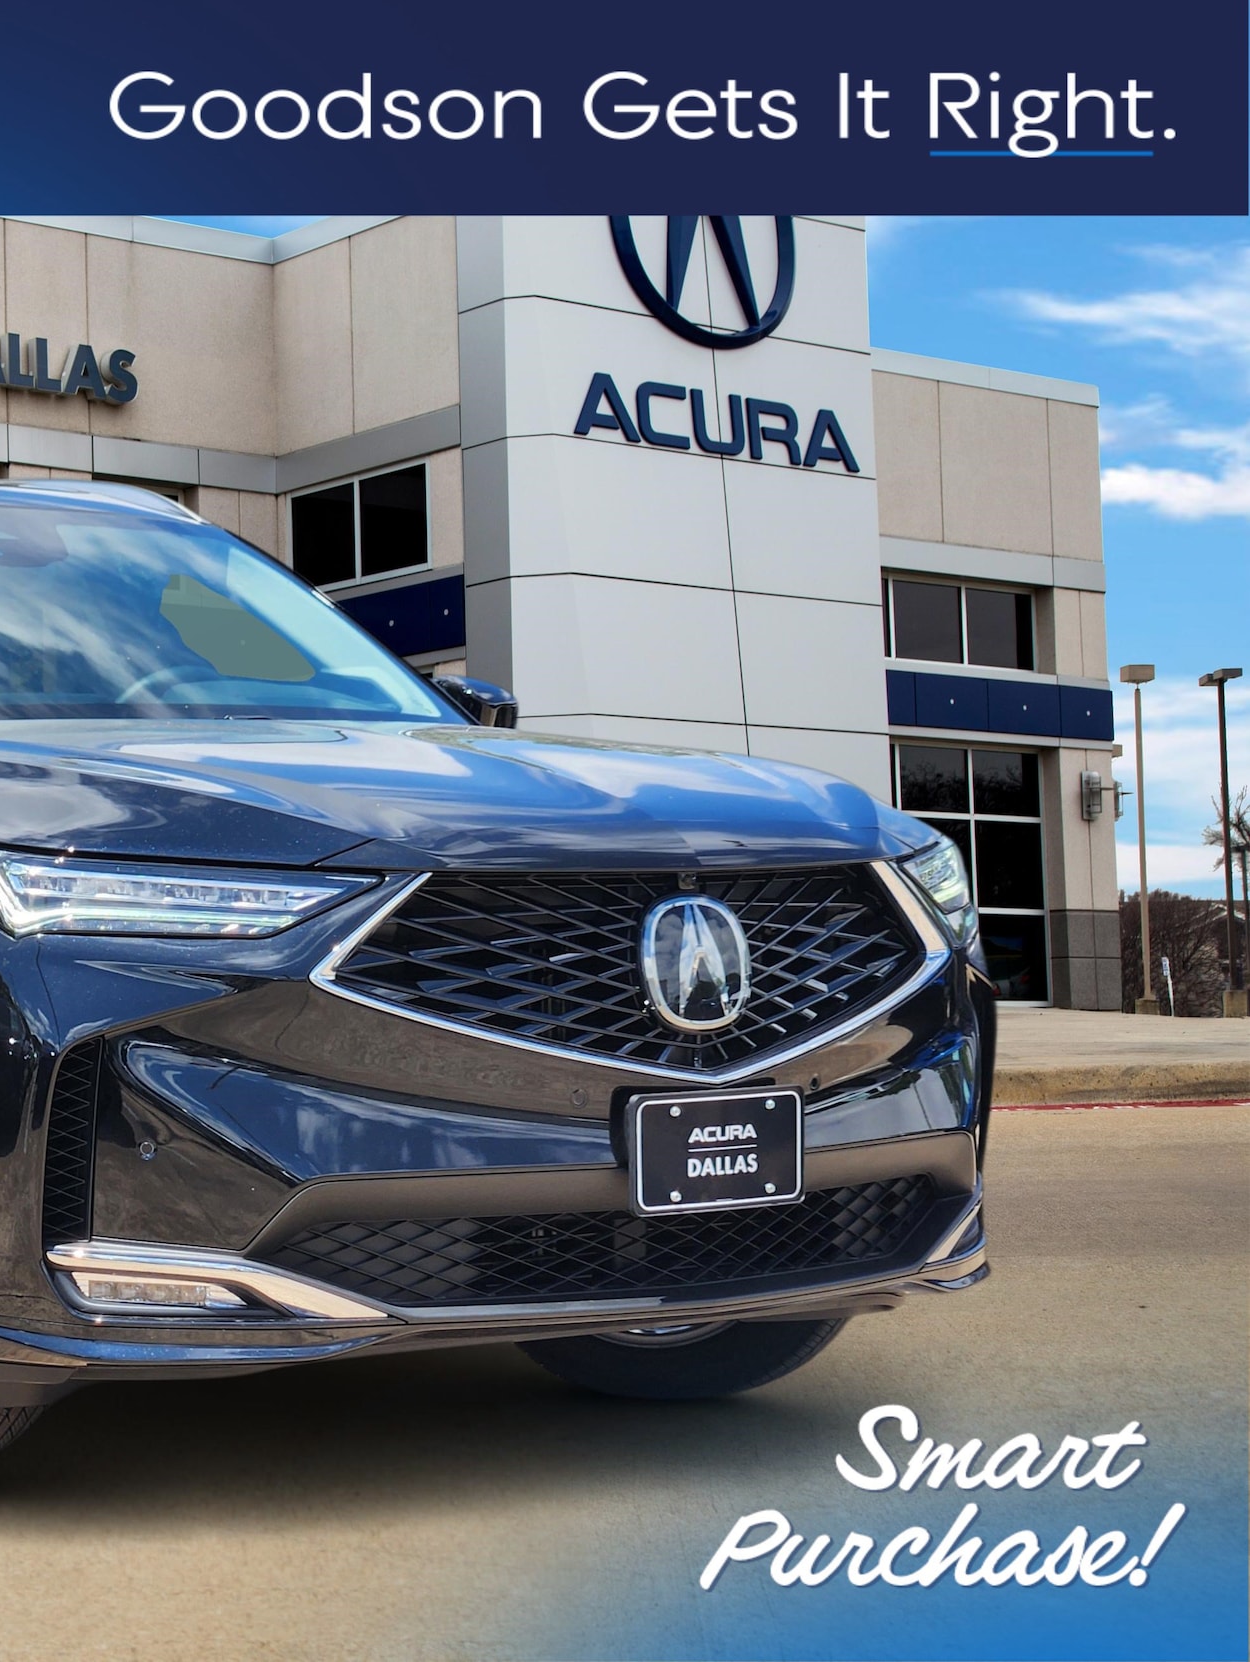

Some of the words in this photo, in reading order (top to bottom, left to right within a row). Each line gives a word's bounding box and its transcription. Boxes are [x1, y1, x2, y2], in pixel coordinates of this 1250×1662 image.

[574, 373, 859, 473] ACURA
[688, 1123, 757, 1144] ACURA
[687, 1153, 759, 1178] DALLAS
